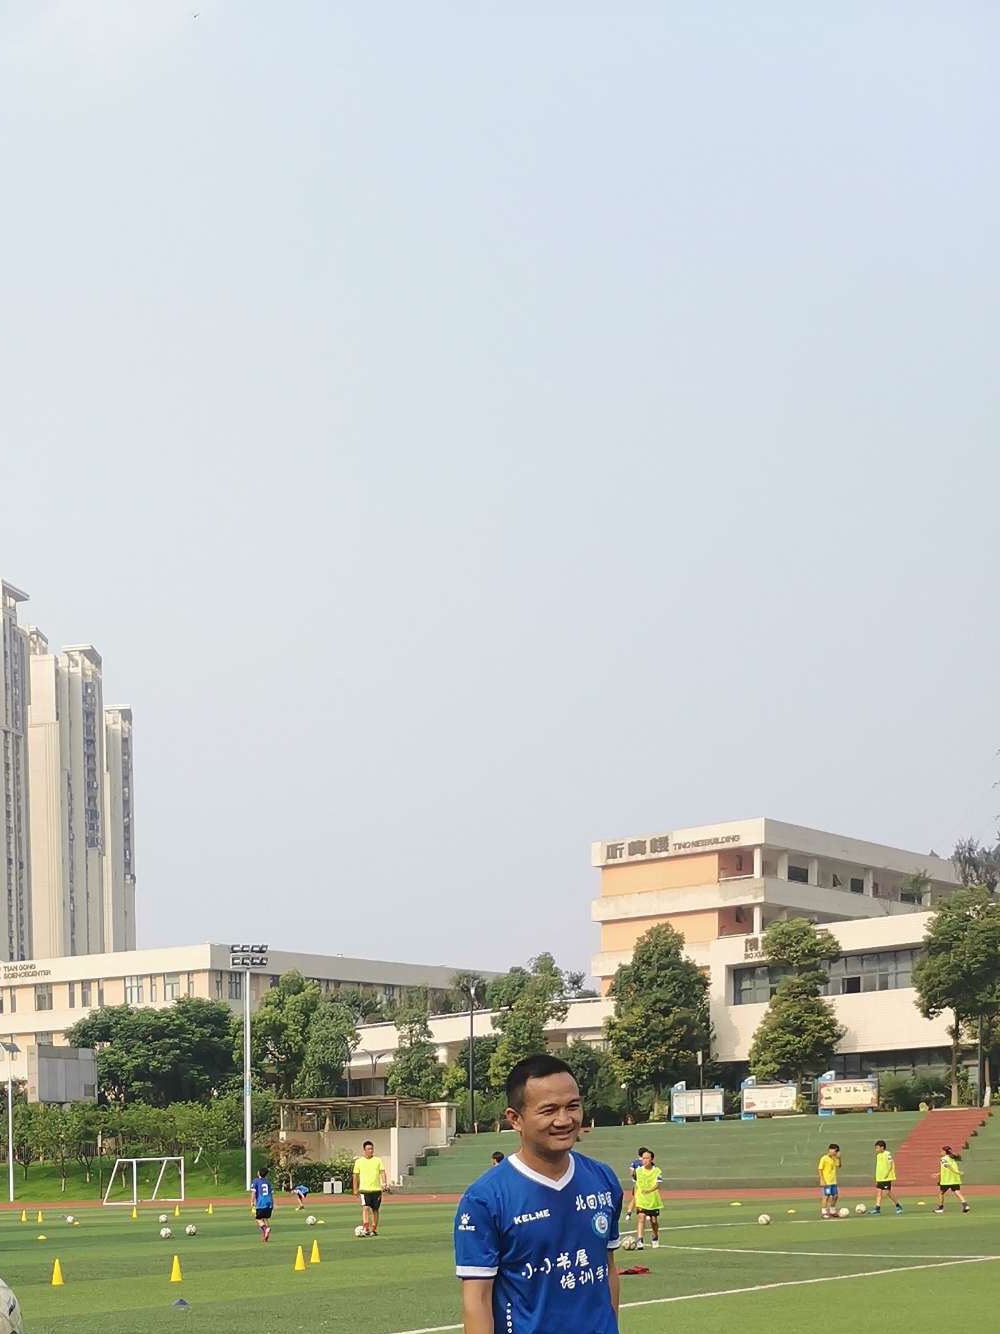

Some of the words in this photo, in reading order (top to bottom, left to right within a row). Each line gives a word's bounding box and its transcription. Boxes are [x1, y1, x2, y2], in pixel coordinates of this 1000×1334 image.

[261, 1183, 269, 1196] 3
[513, 1209, 551, 1225] KELME
[521, 1248, 590, 1279] 小小书屋
[560, 1263, 609, 1289] 培训学
